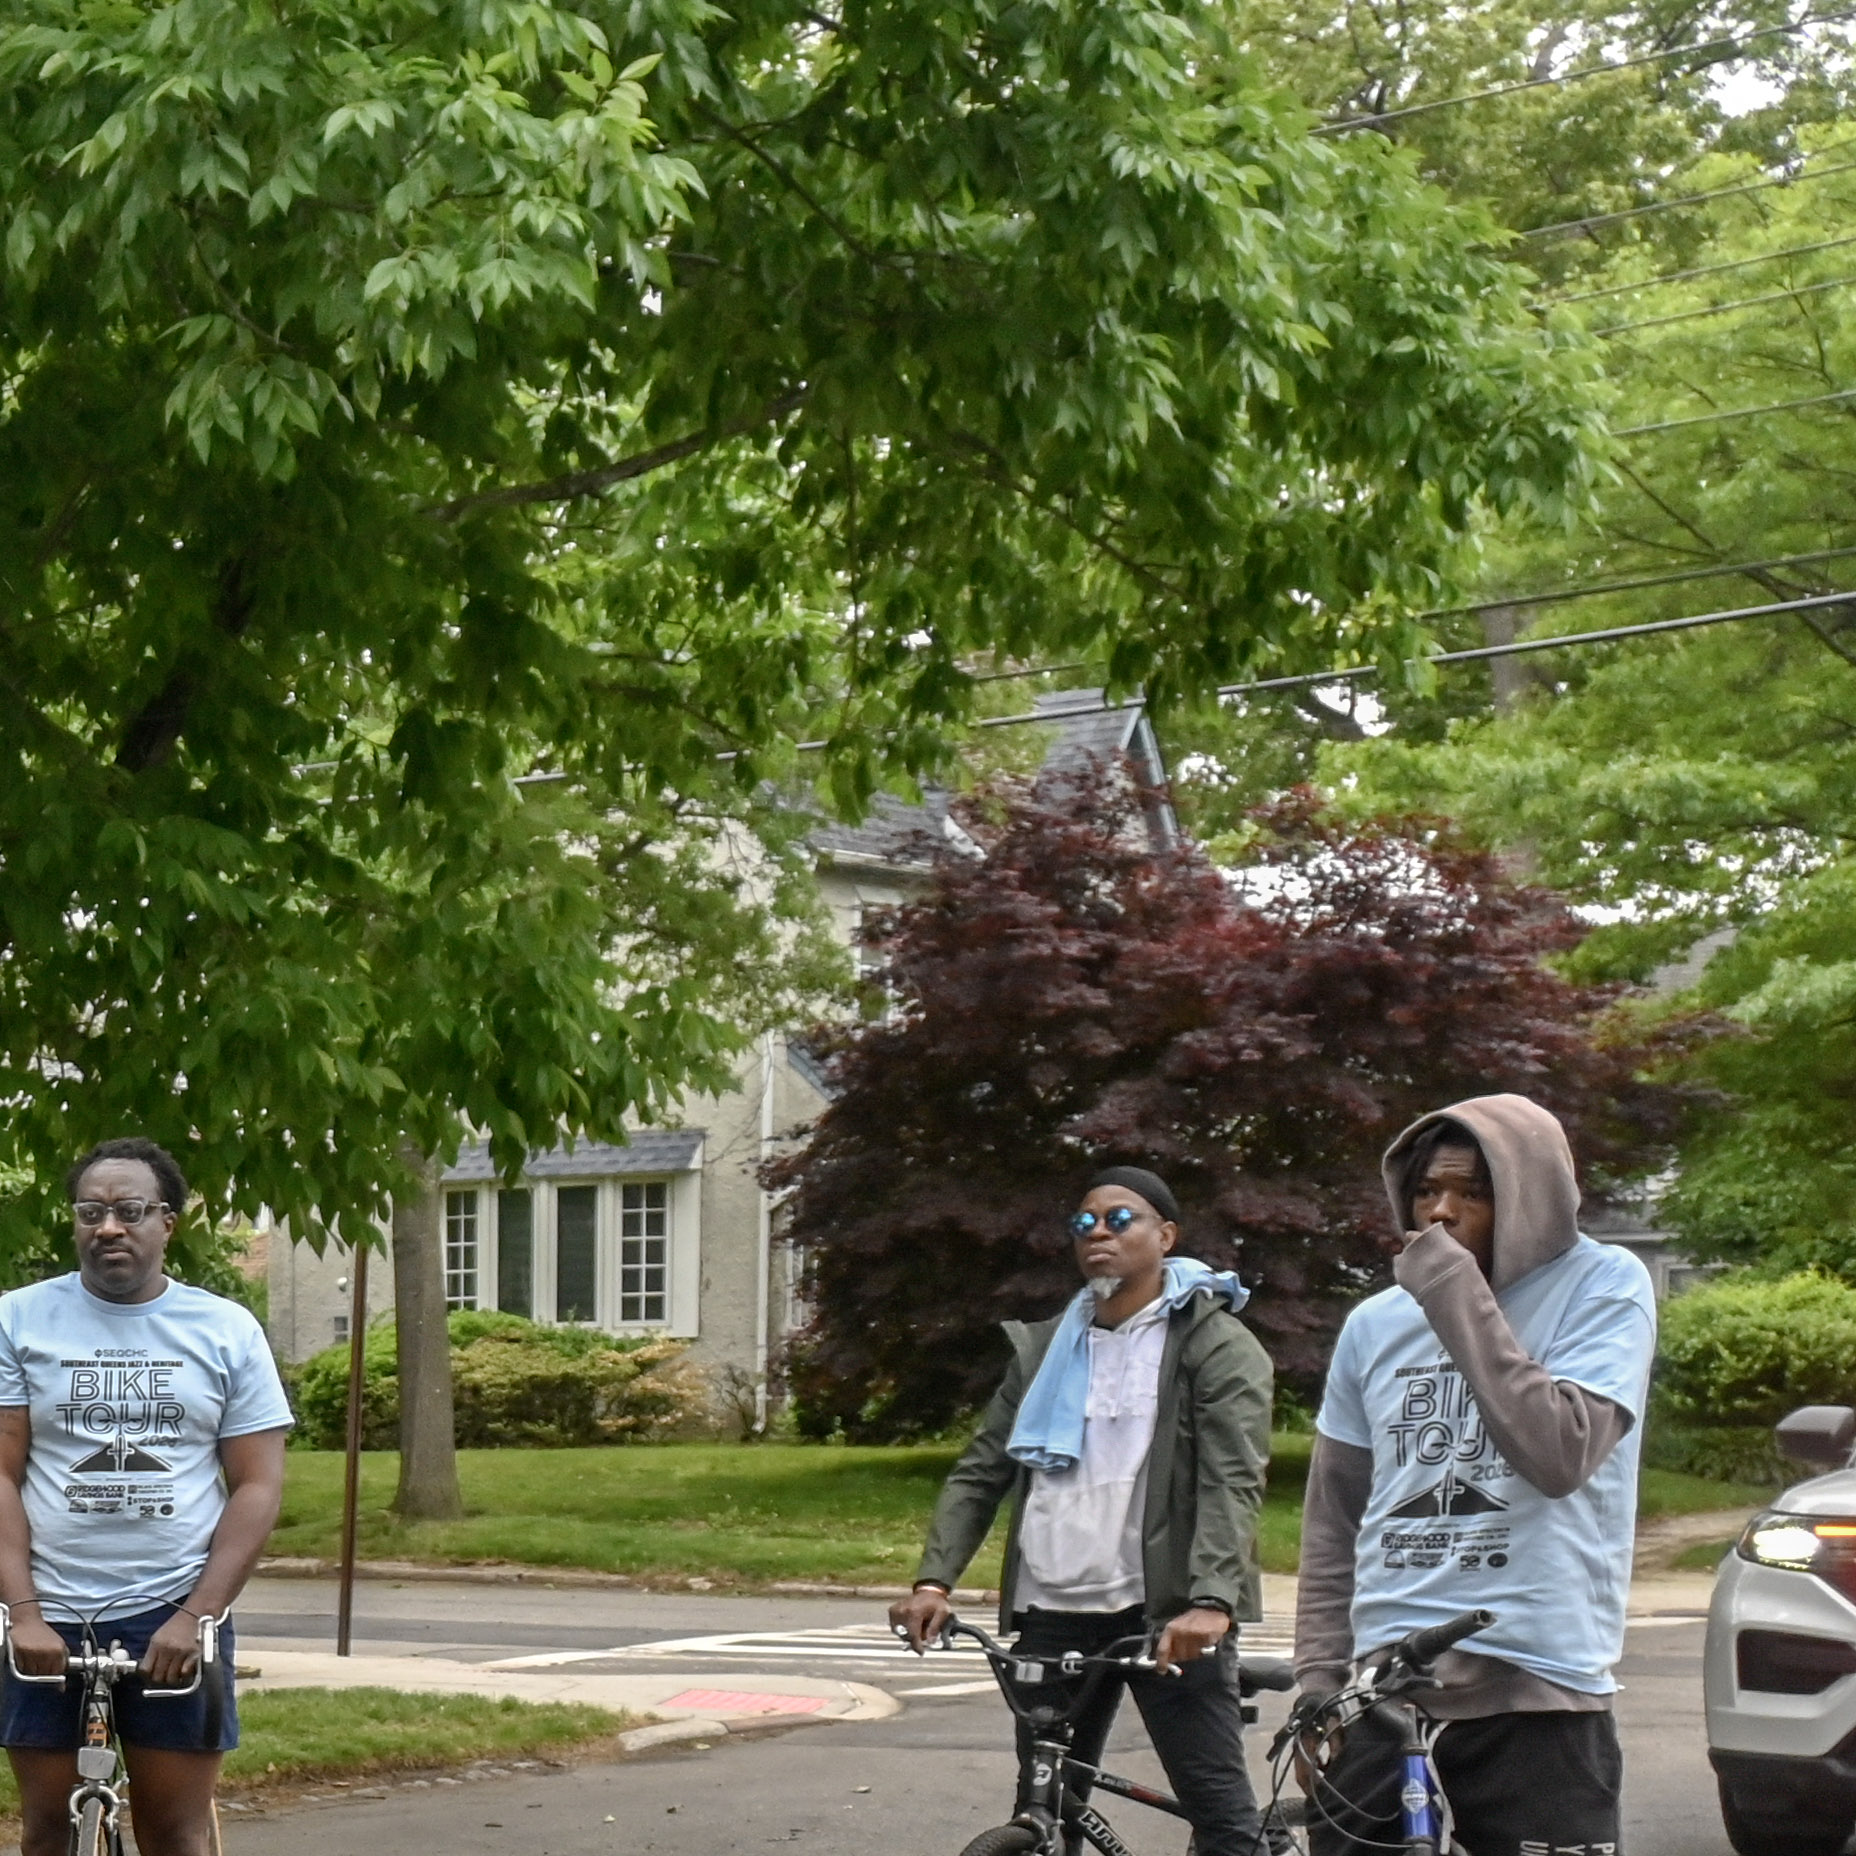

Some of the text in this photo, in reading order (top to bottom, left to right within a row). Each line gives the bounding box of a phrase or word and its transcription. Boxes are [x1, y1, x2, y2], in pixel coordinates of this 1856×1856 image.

[103, 1349, 148, 1358] SEQCHC
[60, 1360, 99, 1368] SOUTHEAST
[100, 1360, 126, 1368] QUEENS
[128, 1360, 143, 1368] JAZZ
[151, 1360, 184, 1368] HERITAGE
[1395, 1365, 1439, 1378] SOUTHEAST
[70, 1369, 175, 1401] BIKE
[56, 1402, 185, 1436] TOUR
